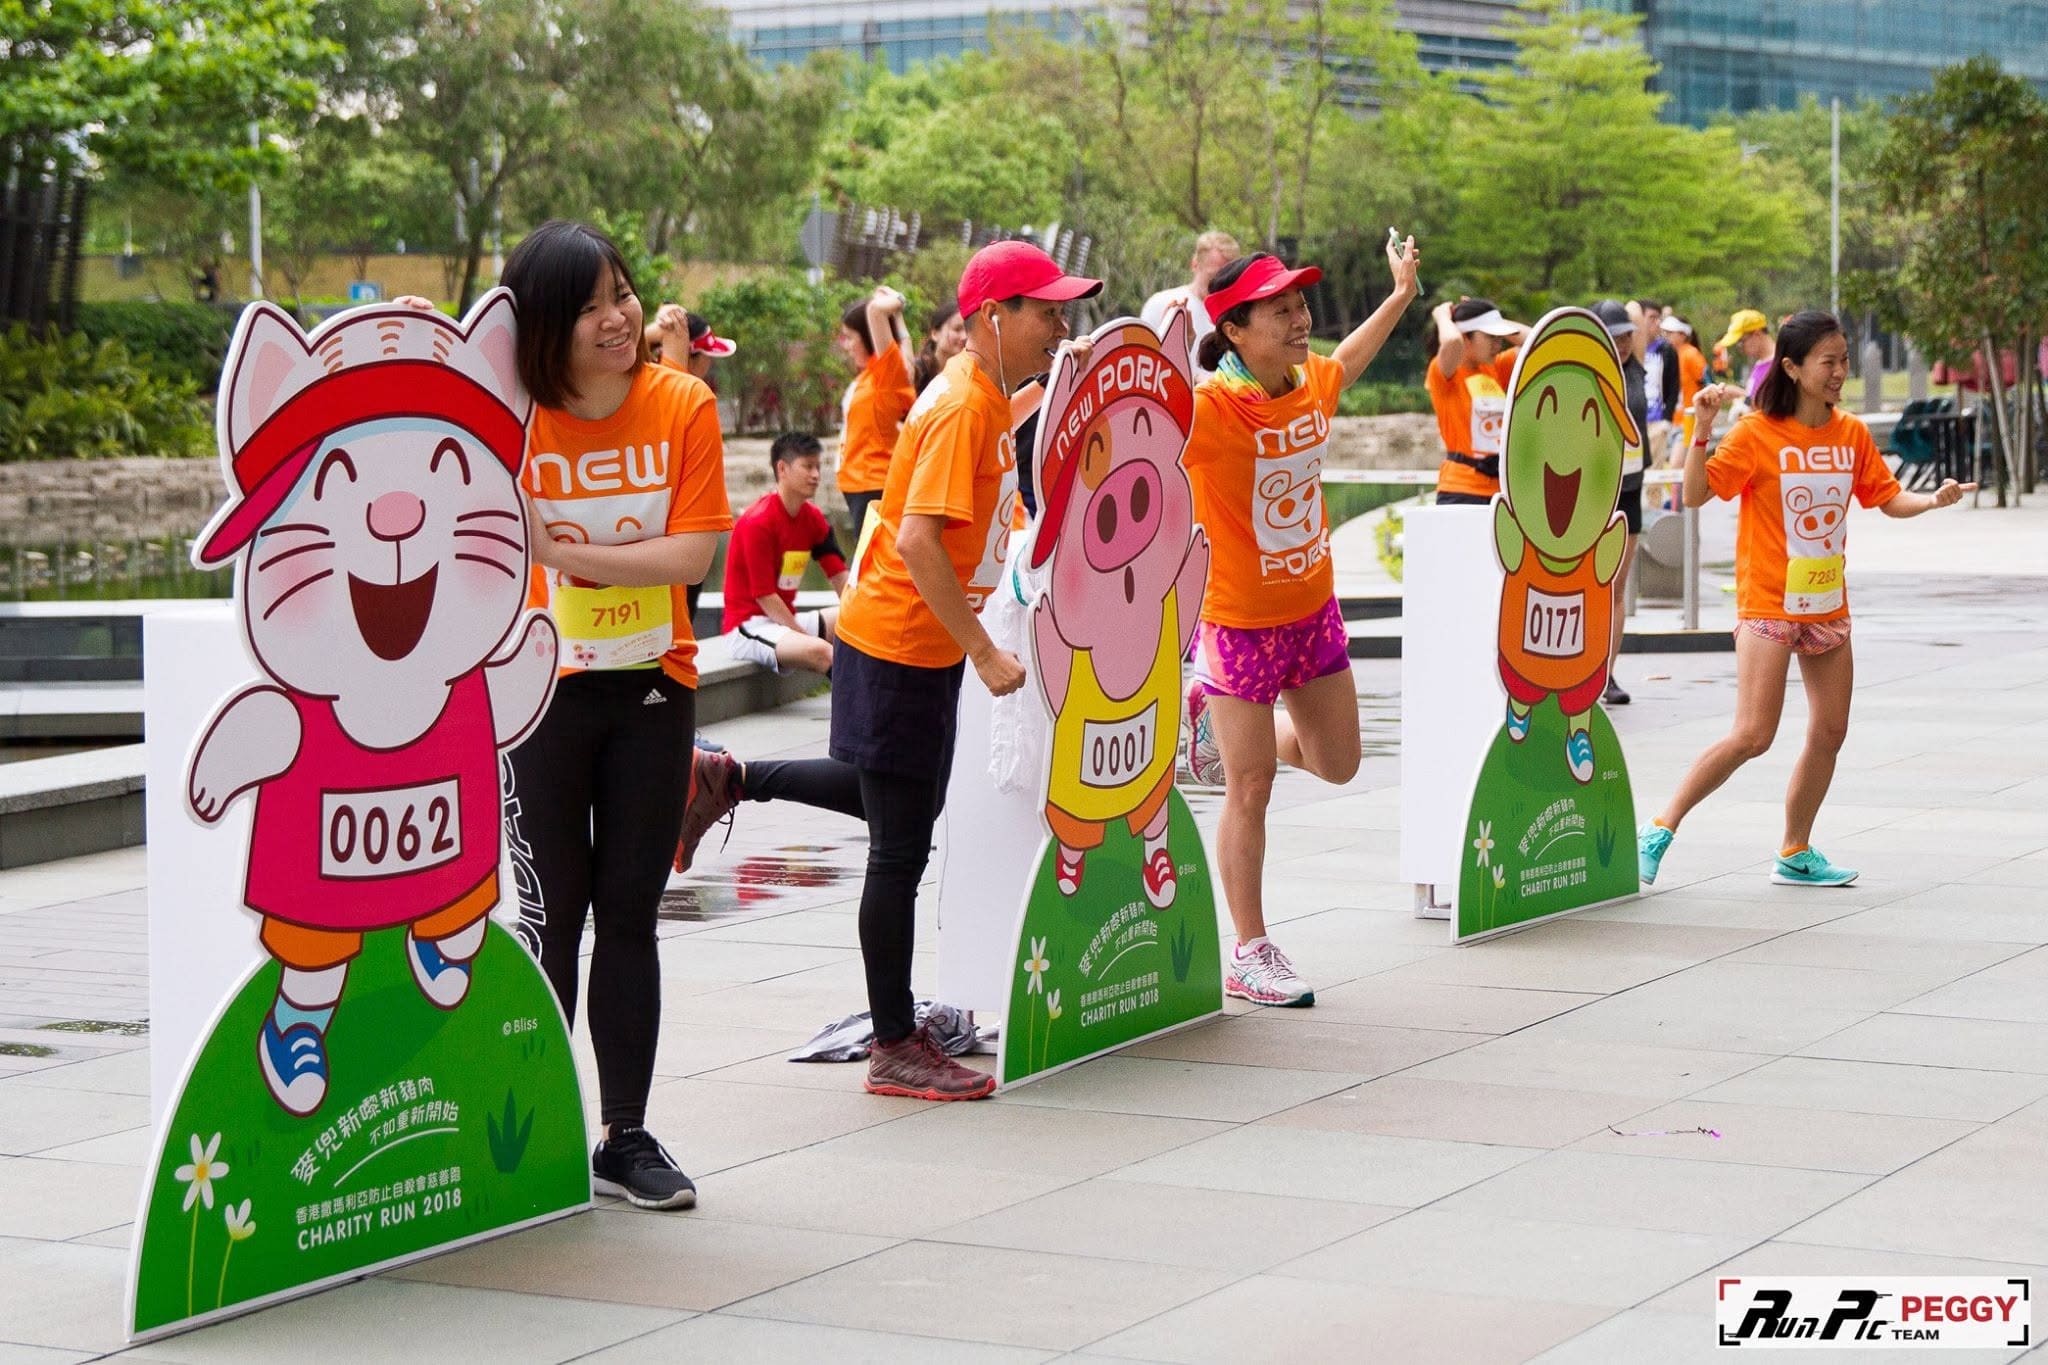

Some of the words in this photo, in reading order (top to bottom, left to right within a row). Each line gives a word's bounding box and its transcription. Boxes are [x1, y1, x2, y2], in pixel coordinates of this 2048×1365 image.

[1098, 354, 1172, 405] PORK
[591, 600, 641, 628] 7191
[1530, 603, 1581, 649] 0177
[1092, 724, 1146, 777] 0001
[330, 796, 454, 865] 0062
[1081, 1001, 1117, 1028] CHARITY
[1119, 995, 1137, 1015] RUN
[1140, 987, 1159, 1008] 2018
[297, 1211, 373, 1251] CHARITY
[380, 1200, 416, 1228] RUN
[422, 1187, 463, 1217] 2018
